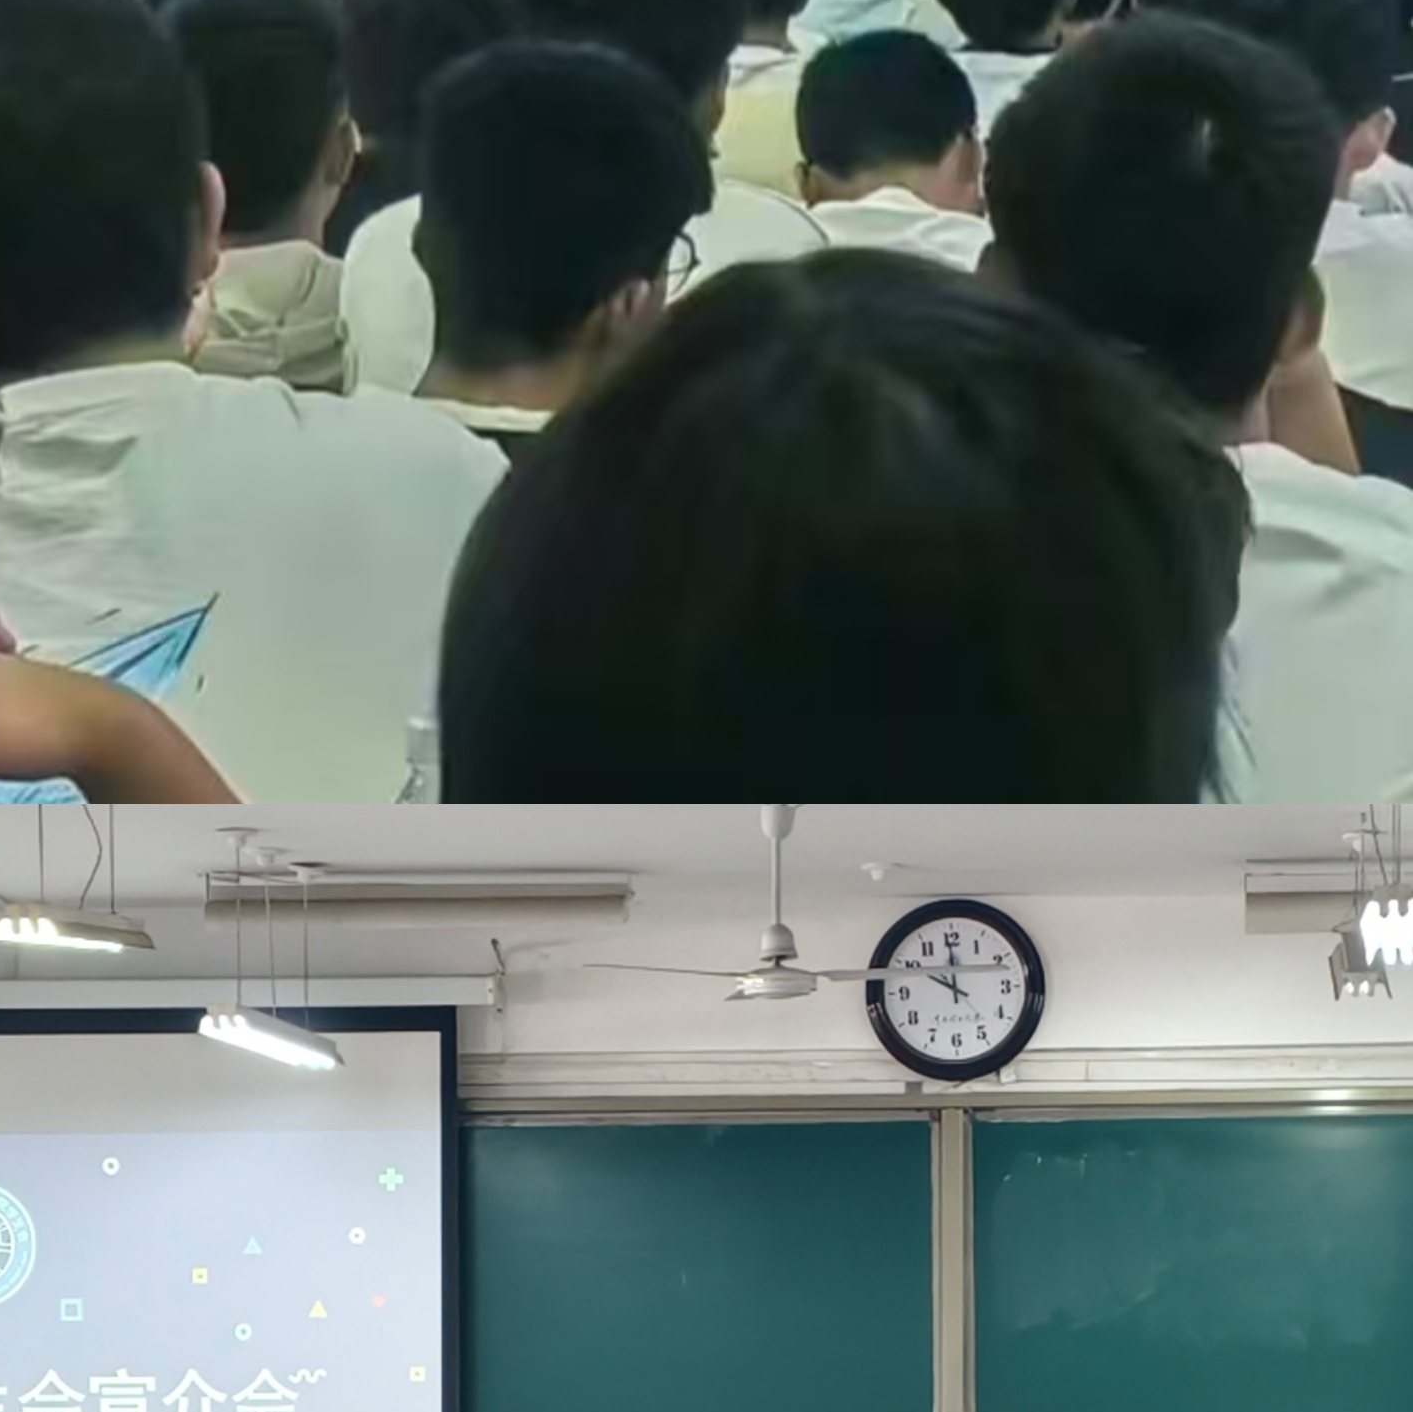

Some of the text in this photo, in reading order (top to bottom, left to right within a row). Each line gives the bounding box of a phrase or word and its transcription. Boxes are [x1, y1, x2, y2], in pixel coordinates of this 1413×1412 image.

[899, 986, 910, 1001] 9
[1001, 979, 1011, 994] 3
[951, 1033, 962, 1048] 6
